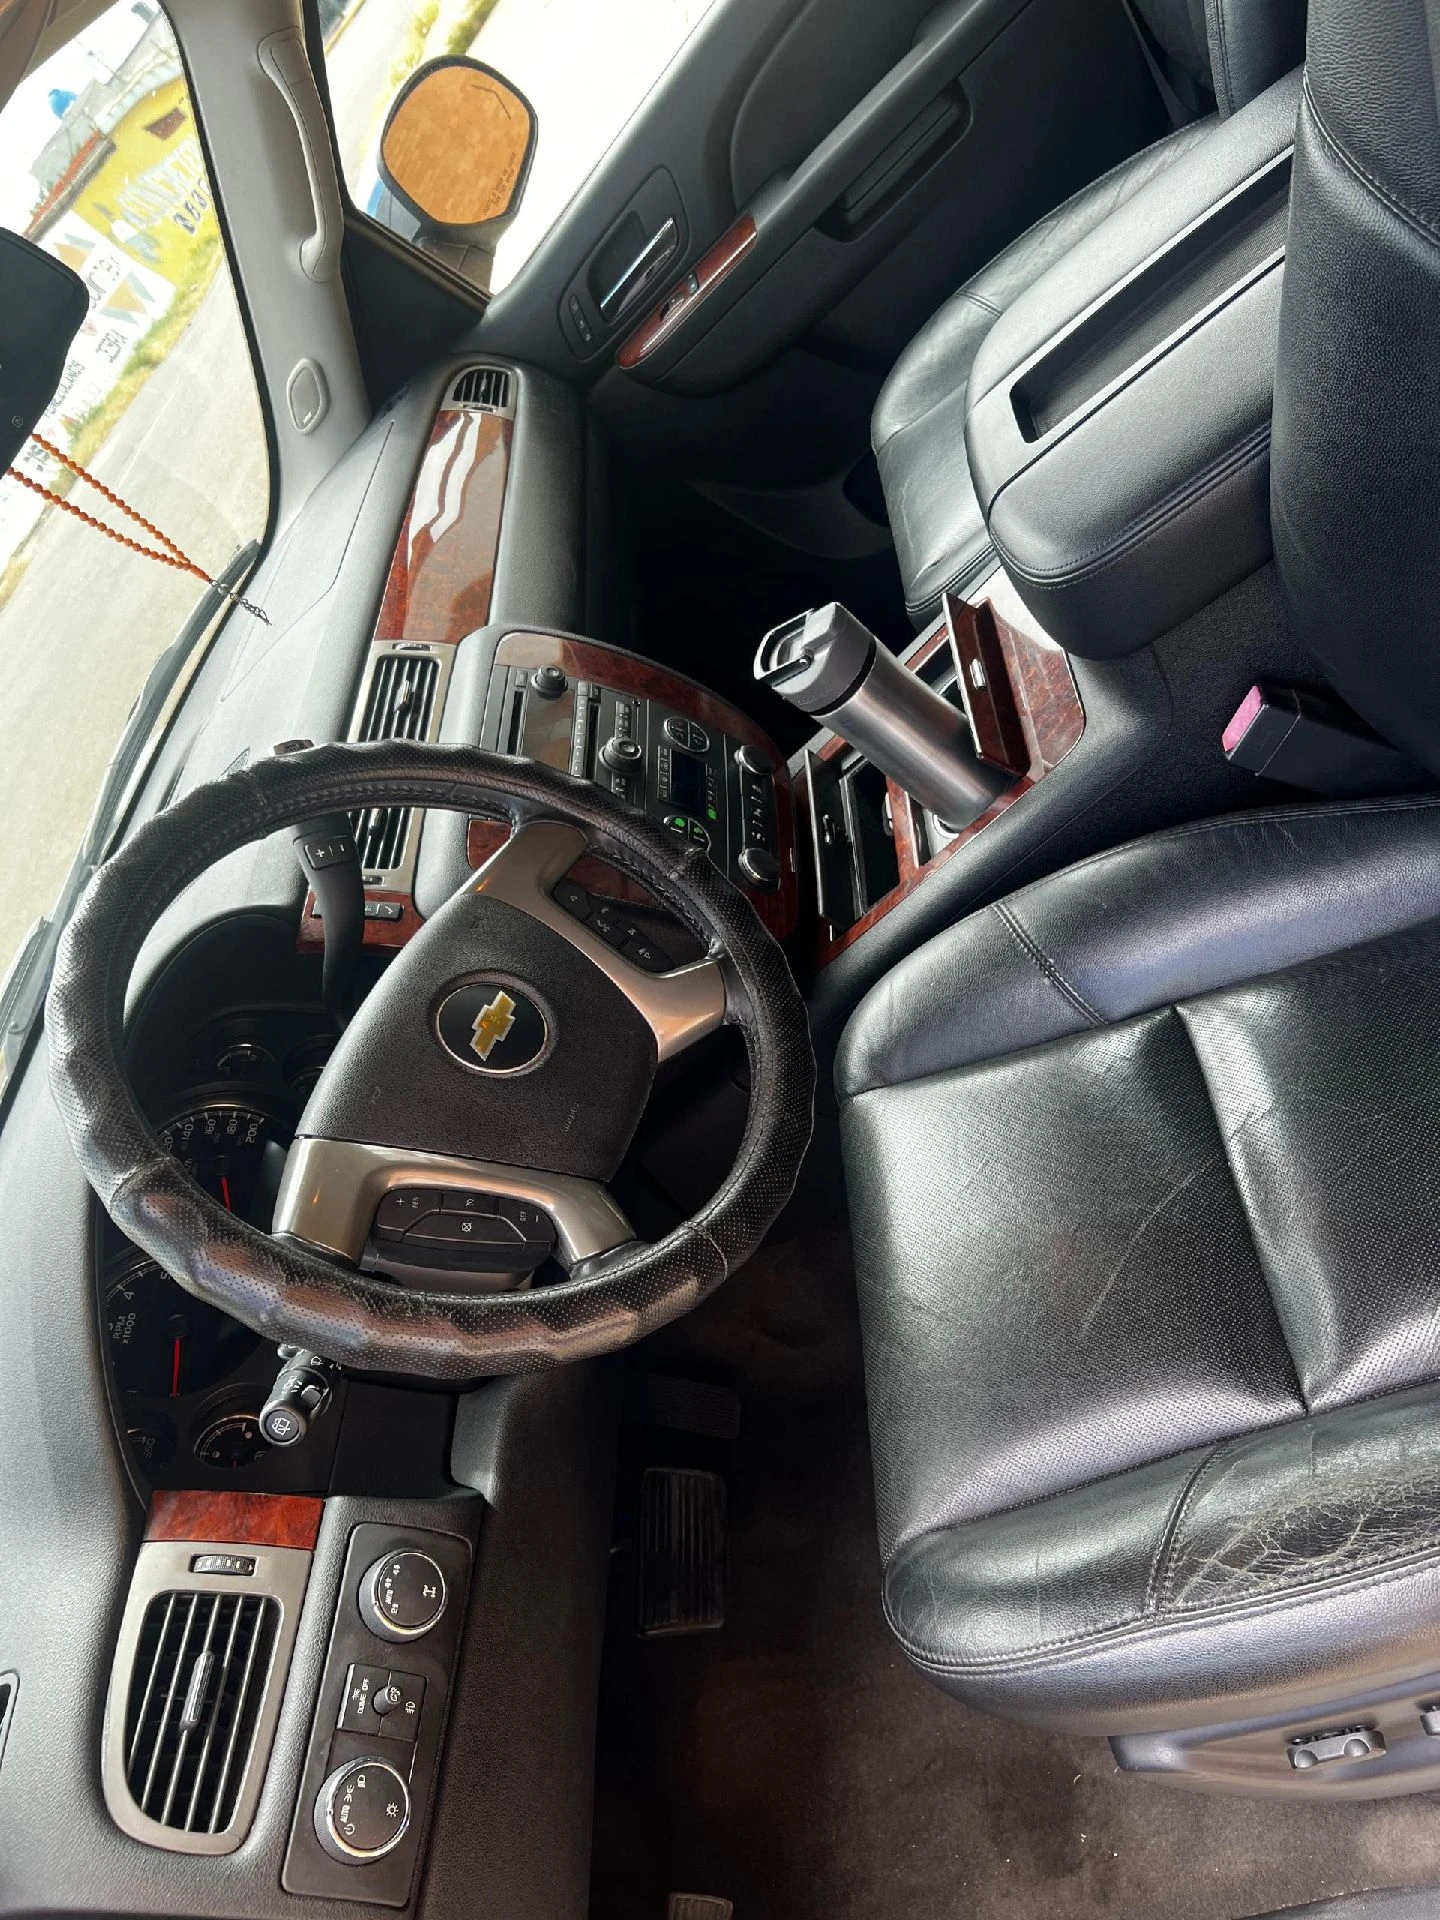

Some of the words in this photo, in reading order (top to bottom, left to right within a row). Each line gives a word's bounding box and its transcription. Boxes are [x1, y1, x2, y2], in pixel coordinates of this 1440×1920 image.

[181, 1123, 194, 1141] 140
[204, 1118, 216, 1135] 160
[227, 1118, 238, 1135] 180
[245, 1123, 259, 1144] 200
[123, 1291, 134, 1300] 4
[112, 1316, 126, 1339] RPM
[339, 1804, 351, 1823] AUTO
